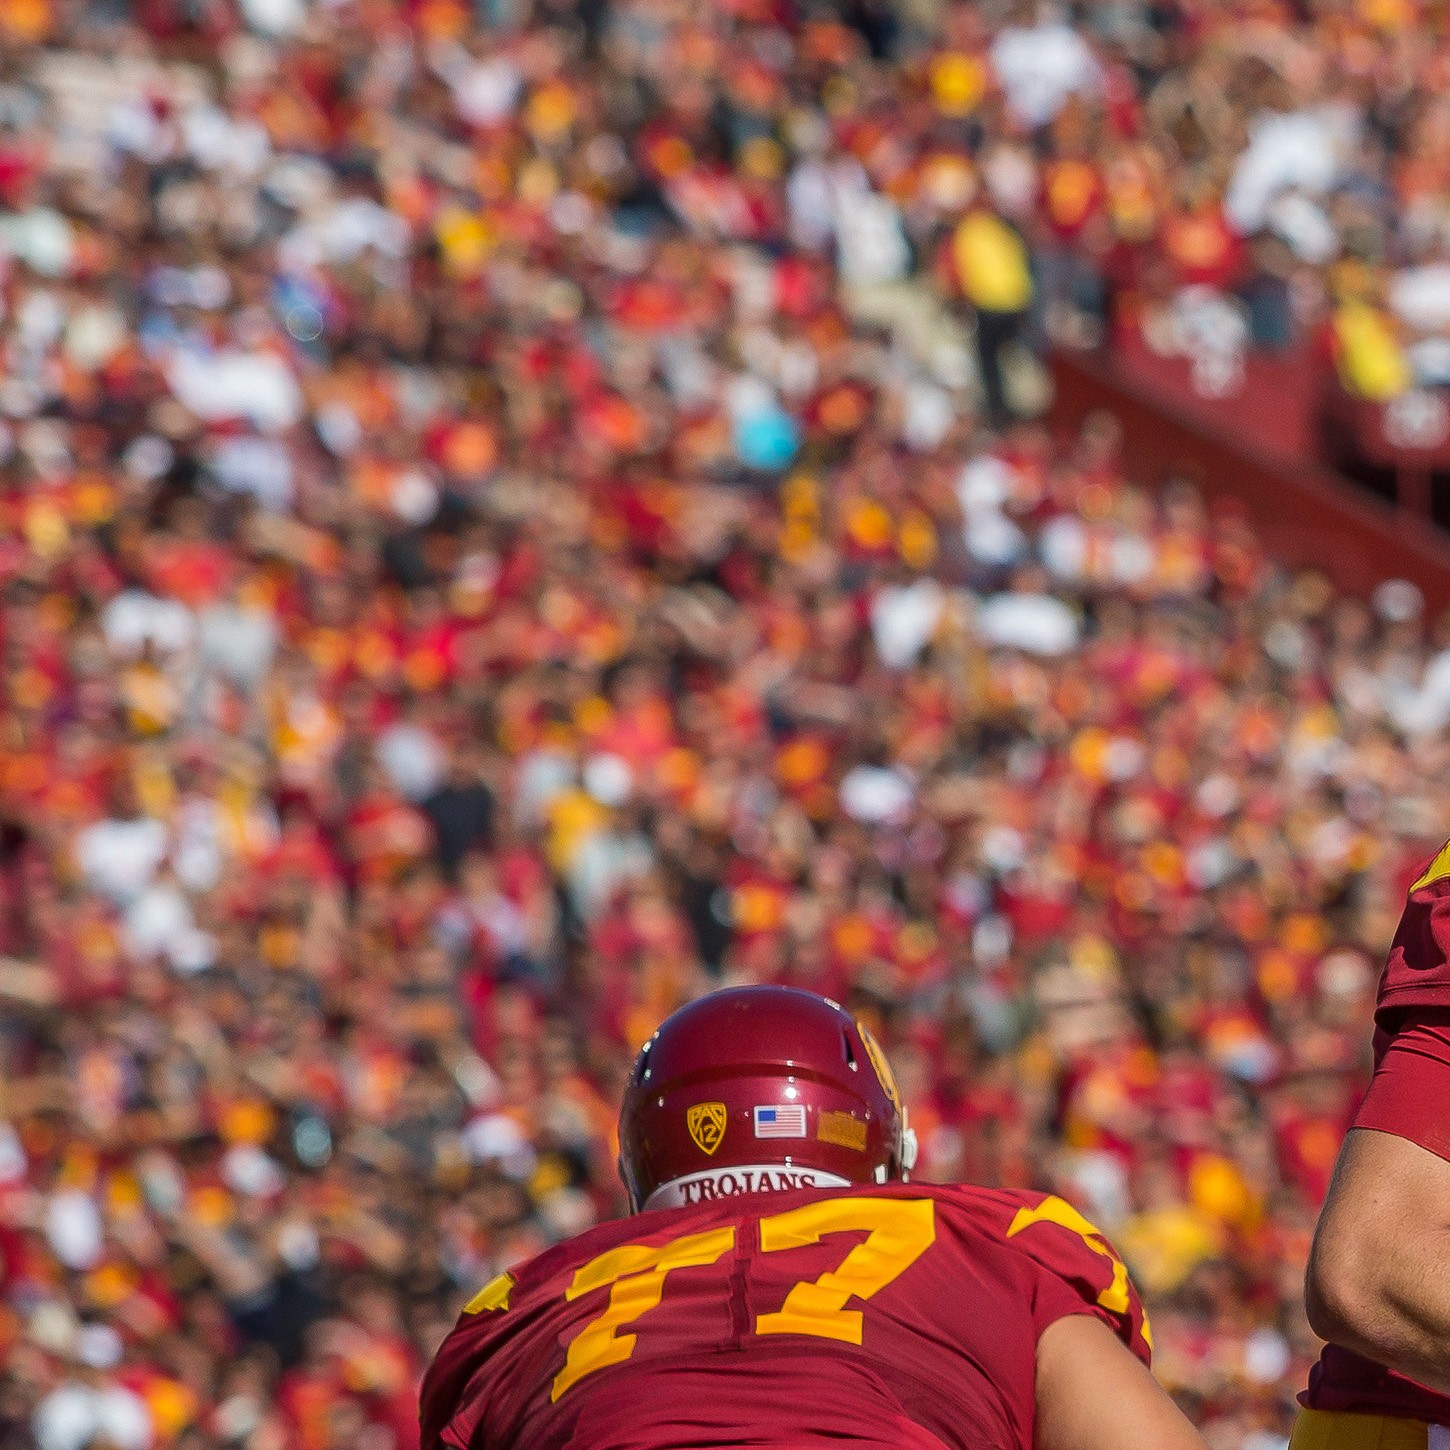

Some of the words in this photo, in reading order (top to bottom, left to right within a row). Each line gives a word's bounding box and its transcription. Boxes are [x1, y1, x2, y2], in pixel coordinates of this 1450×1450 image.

[698, 1124, 718, 1144] 12
[678, 1171, 816, 1206] TROJANS
[551, 1198, 936, 1402] 77
